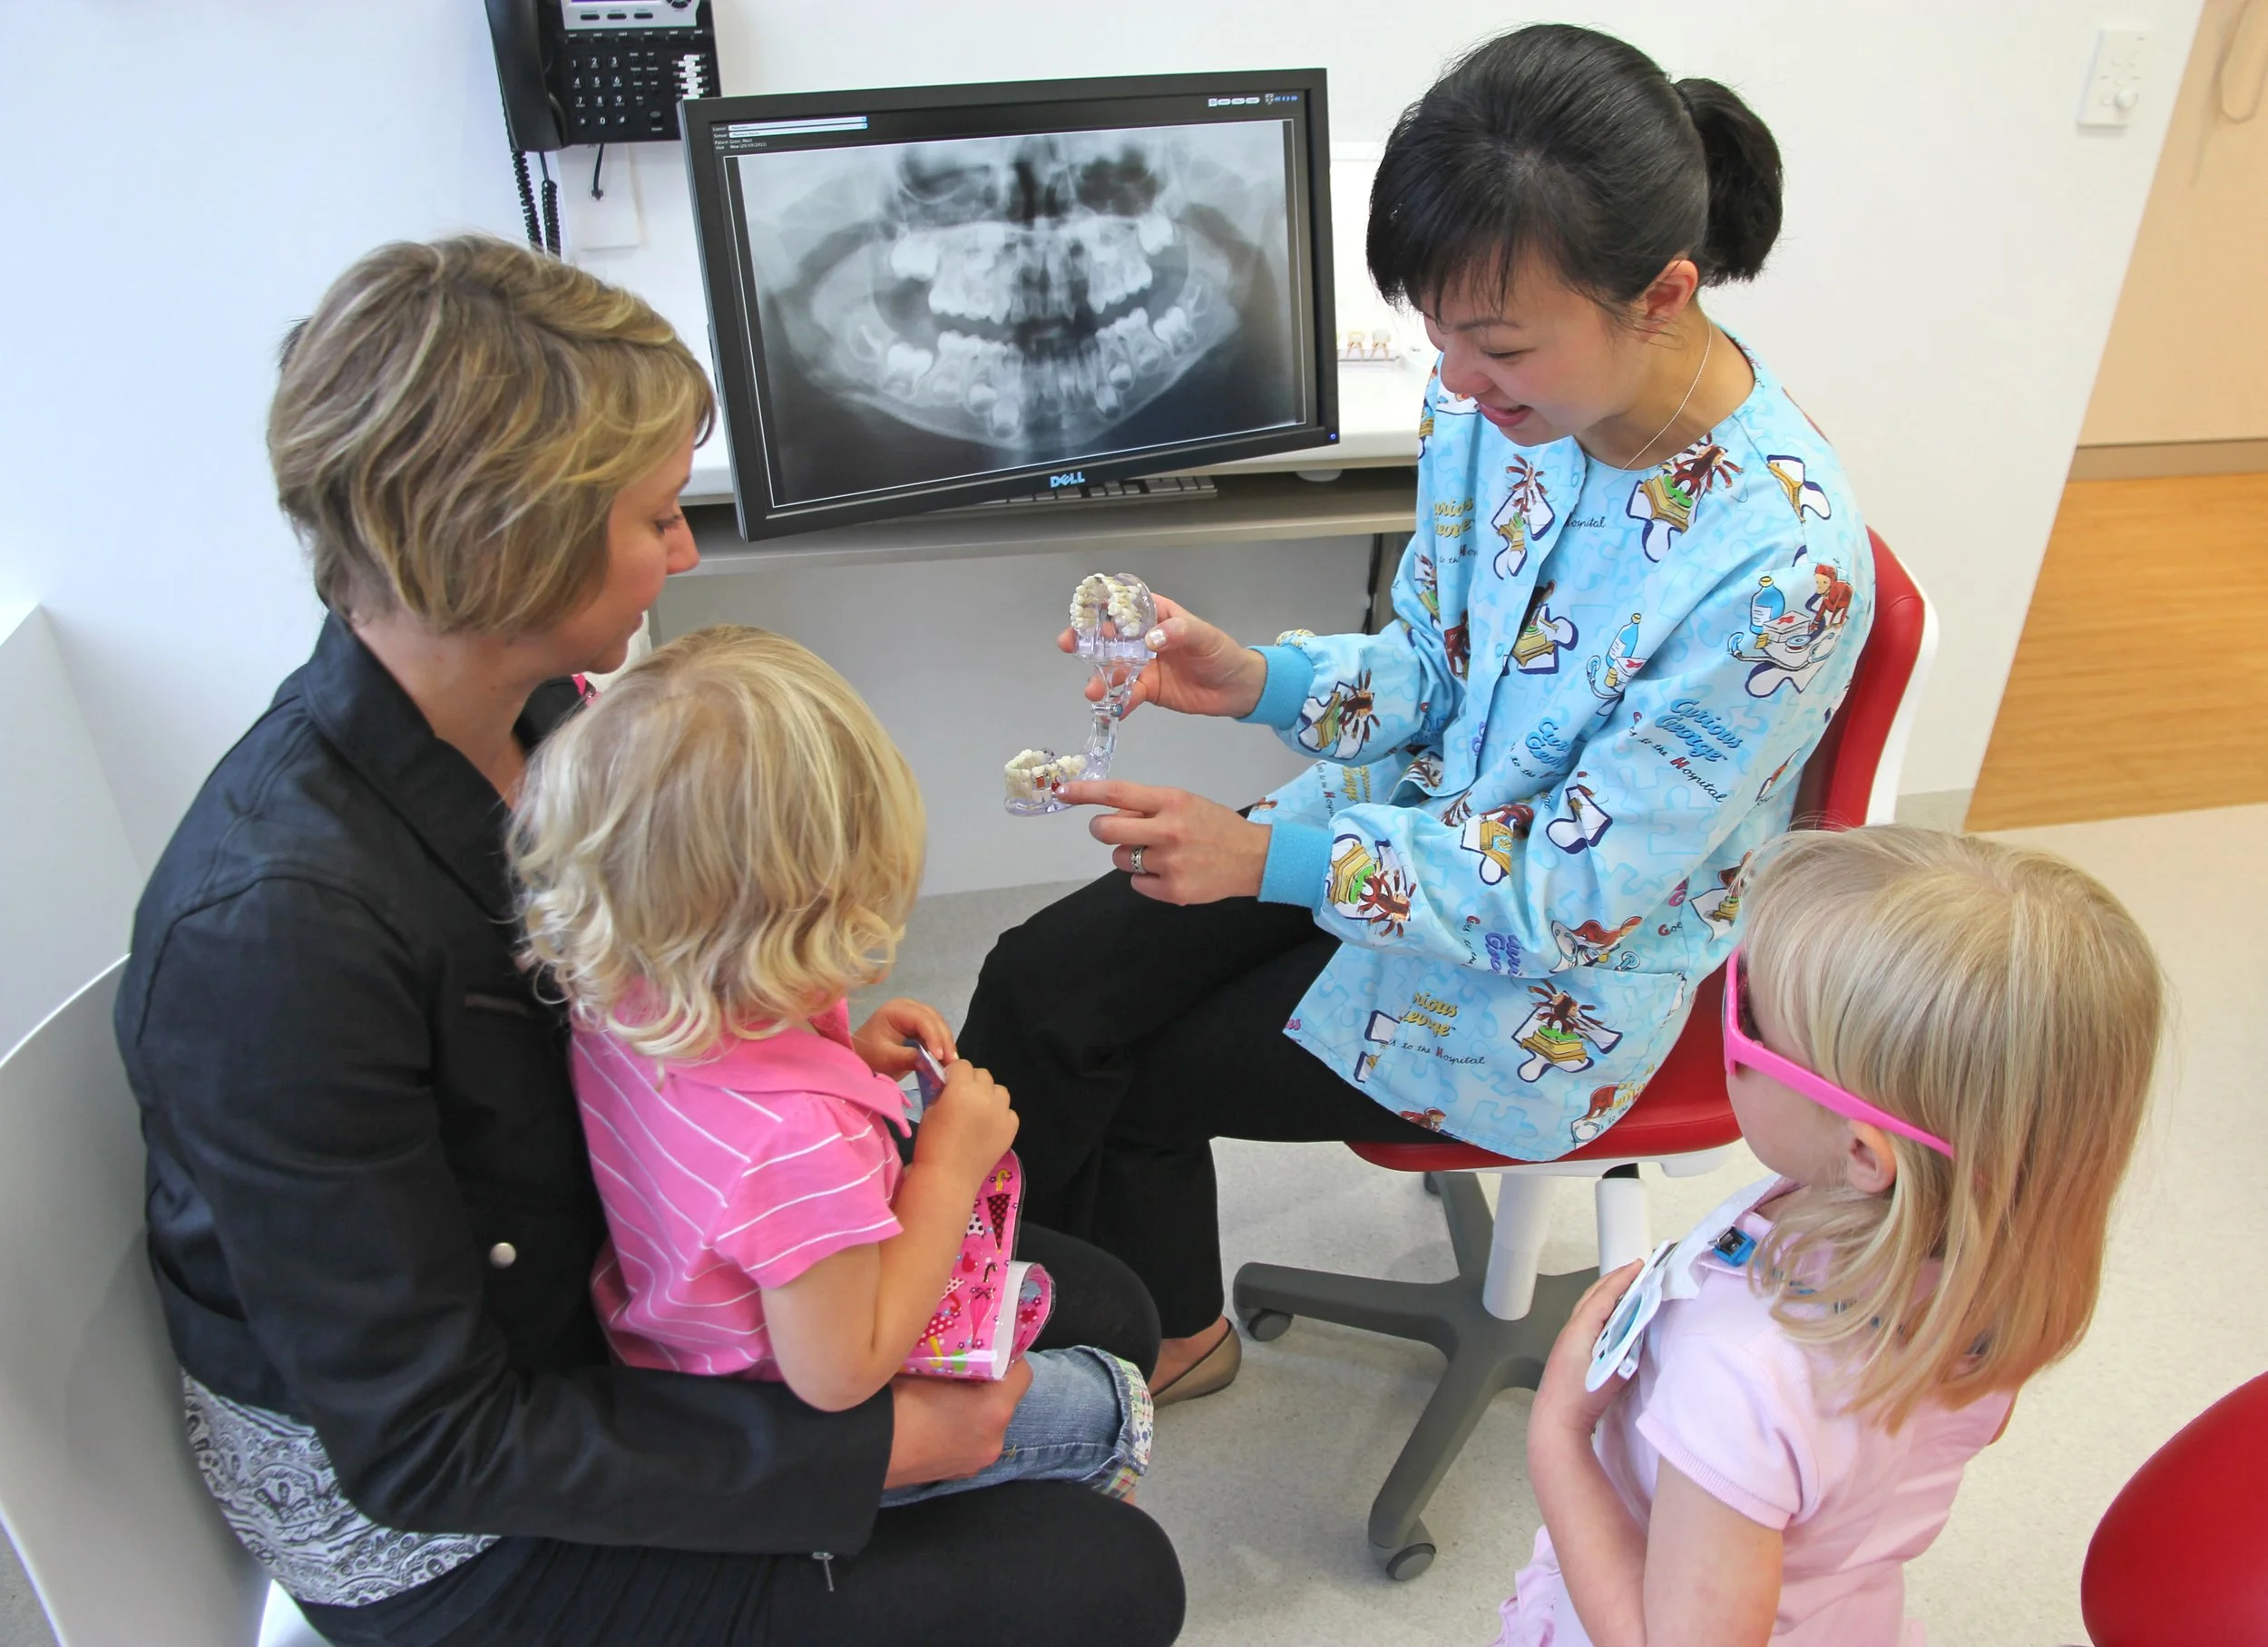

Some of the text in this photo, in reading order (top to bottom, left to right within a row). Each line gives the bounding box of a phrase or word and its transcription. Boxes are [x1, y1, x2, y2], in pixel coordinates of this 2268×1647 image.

[1050, 471, 1086, 488] DELL
[1670, 698, 1743, 748] Curious
[1653, 744, 1667, 757] the
[1669, 756, 1727, 803] Hospital
[1435, 1046, 1487, 1066] Hospital
